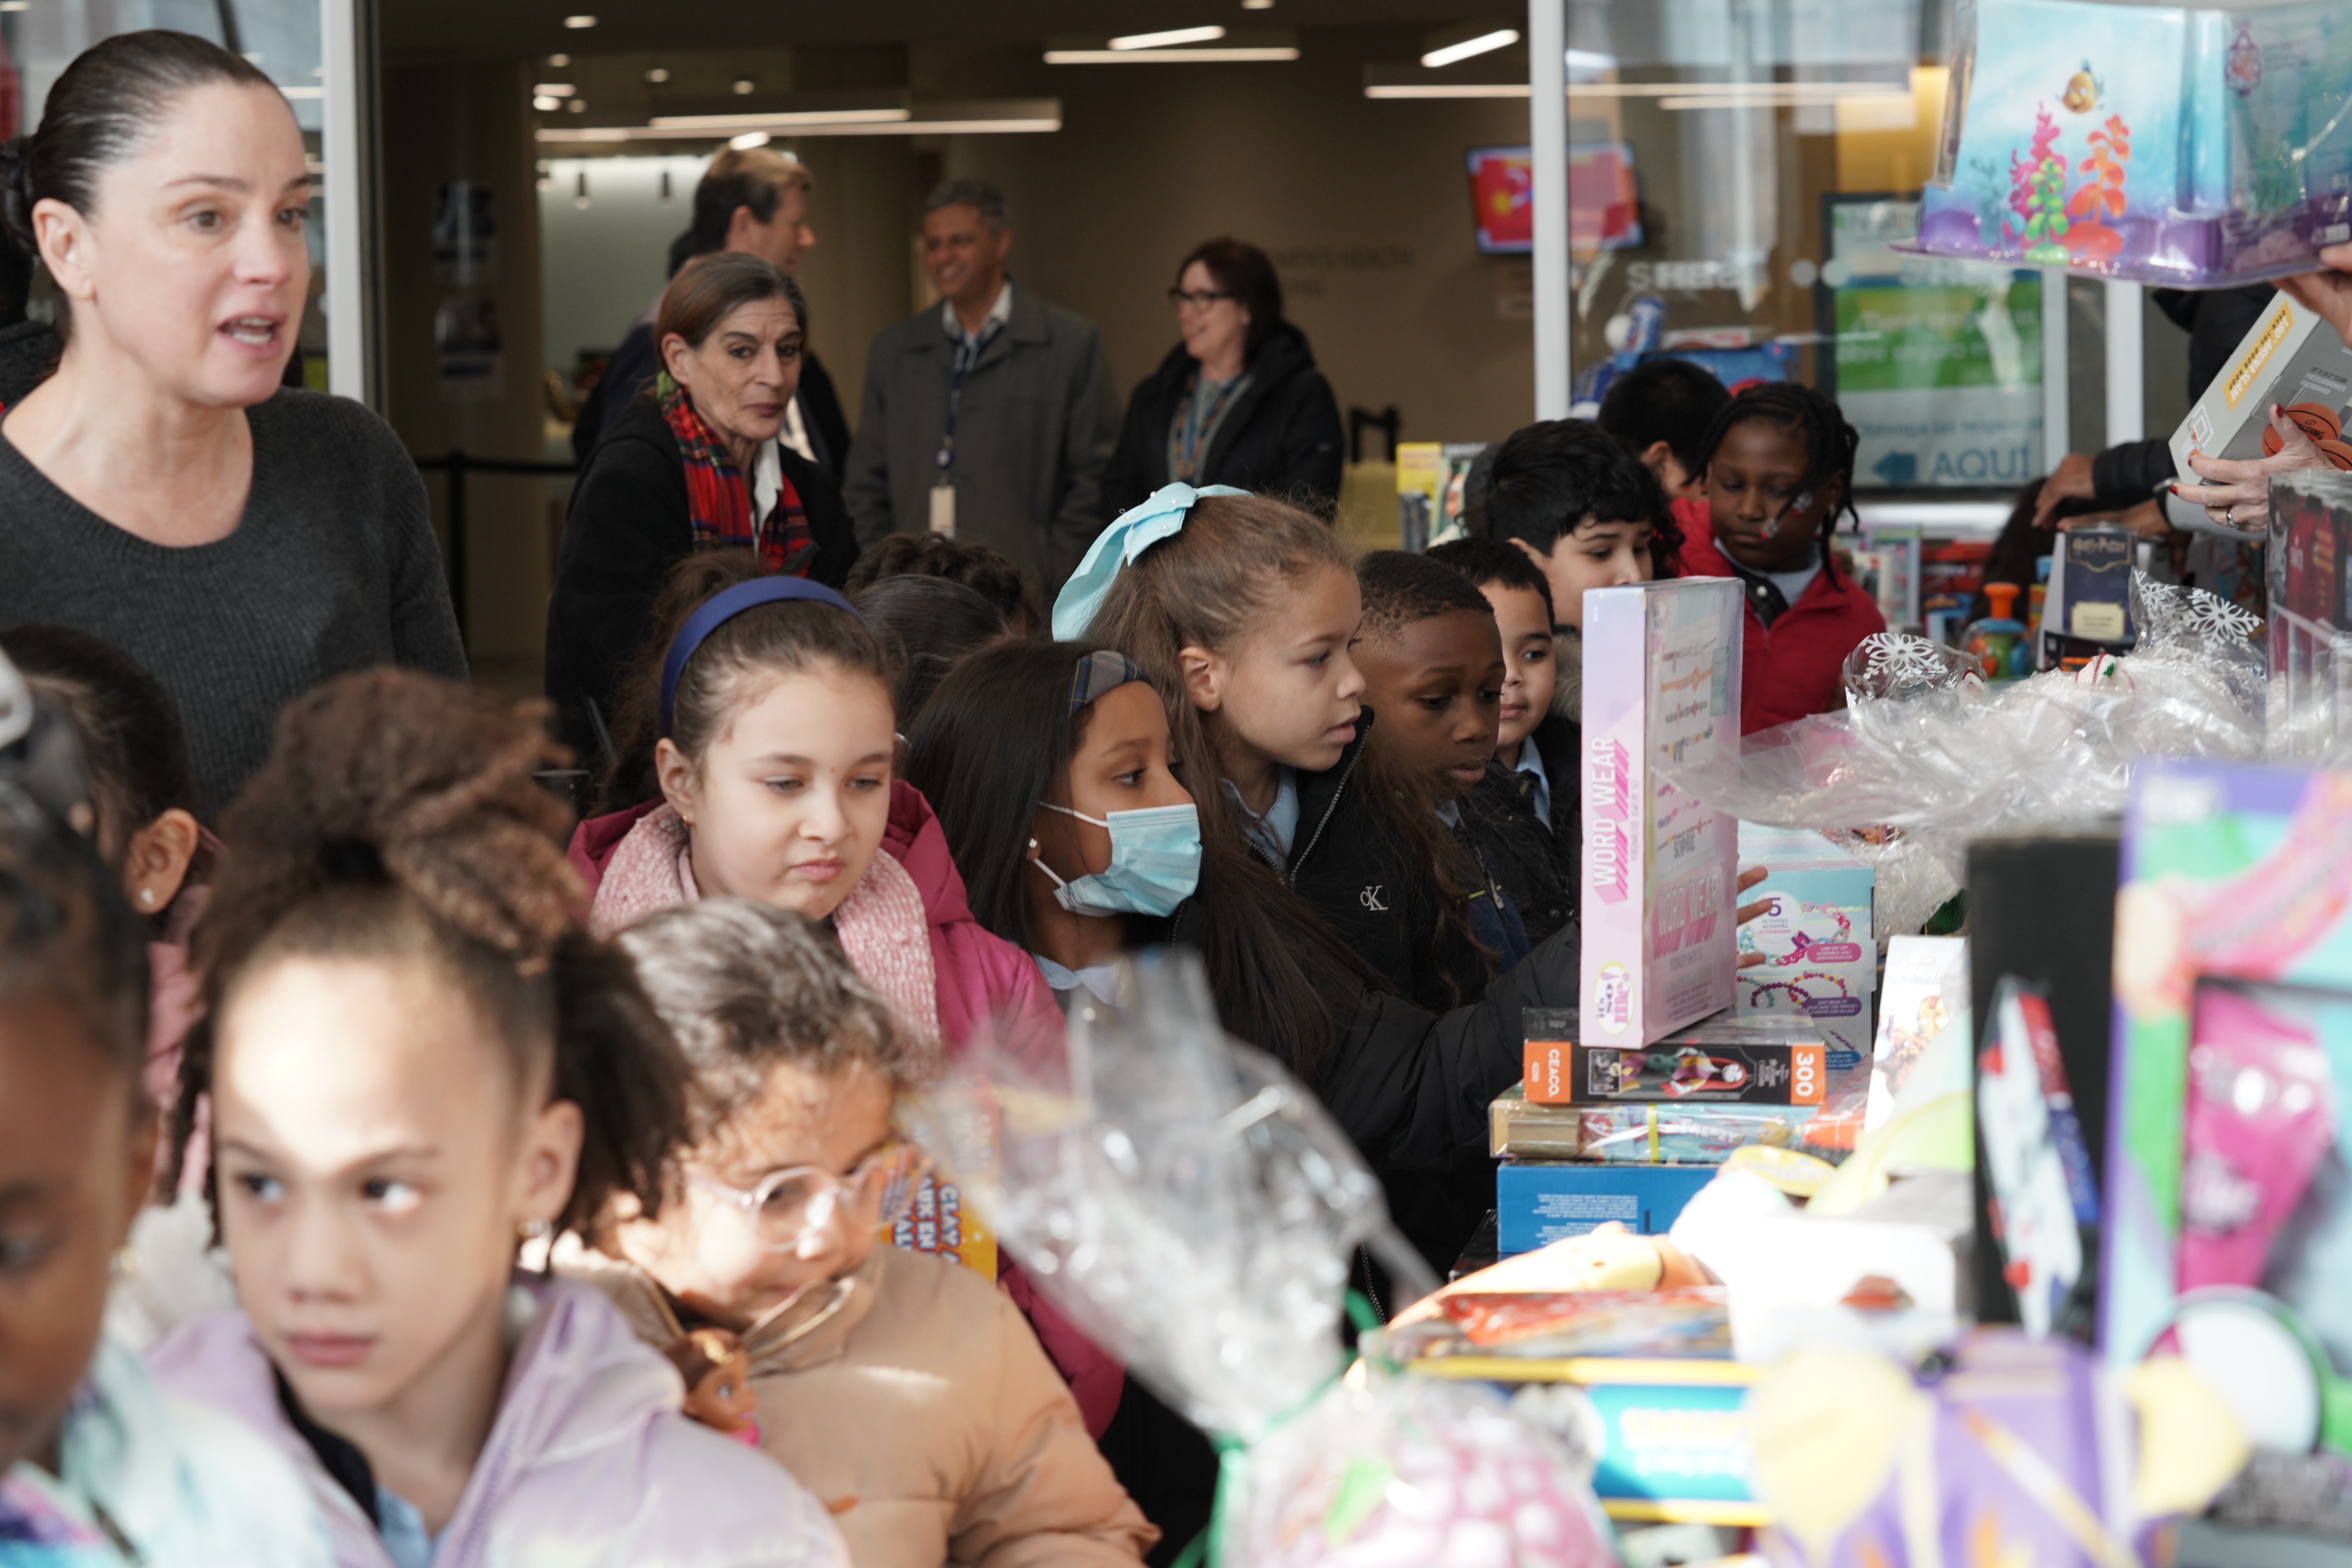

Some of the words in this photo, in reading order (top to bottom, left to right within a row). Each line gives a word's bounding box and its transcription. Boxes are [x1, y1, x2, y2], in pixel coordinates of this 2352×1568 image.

[1591, 737, 1617, 807] WEAR
[1592, 818, 1617, 887] WORD
[1768, 897, 1782, 916] 5
[1795, 1051, 1815, 1097] 300
[938, 1184, 960, 1247] CLAY
